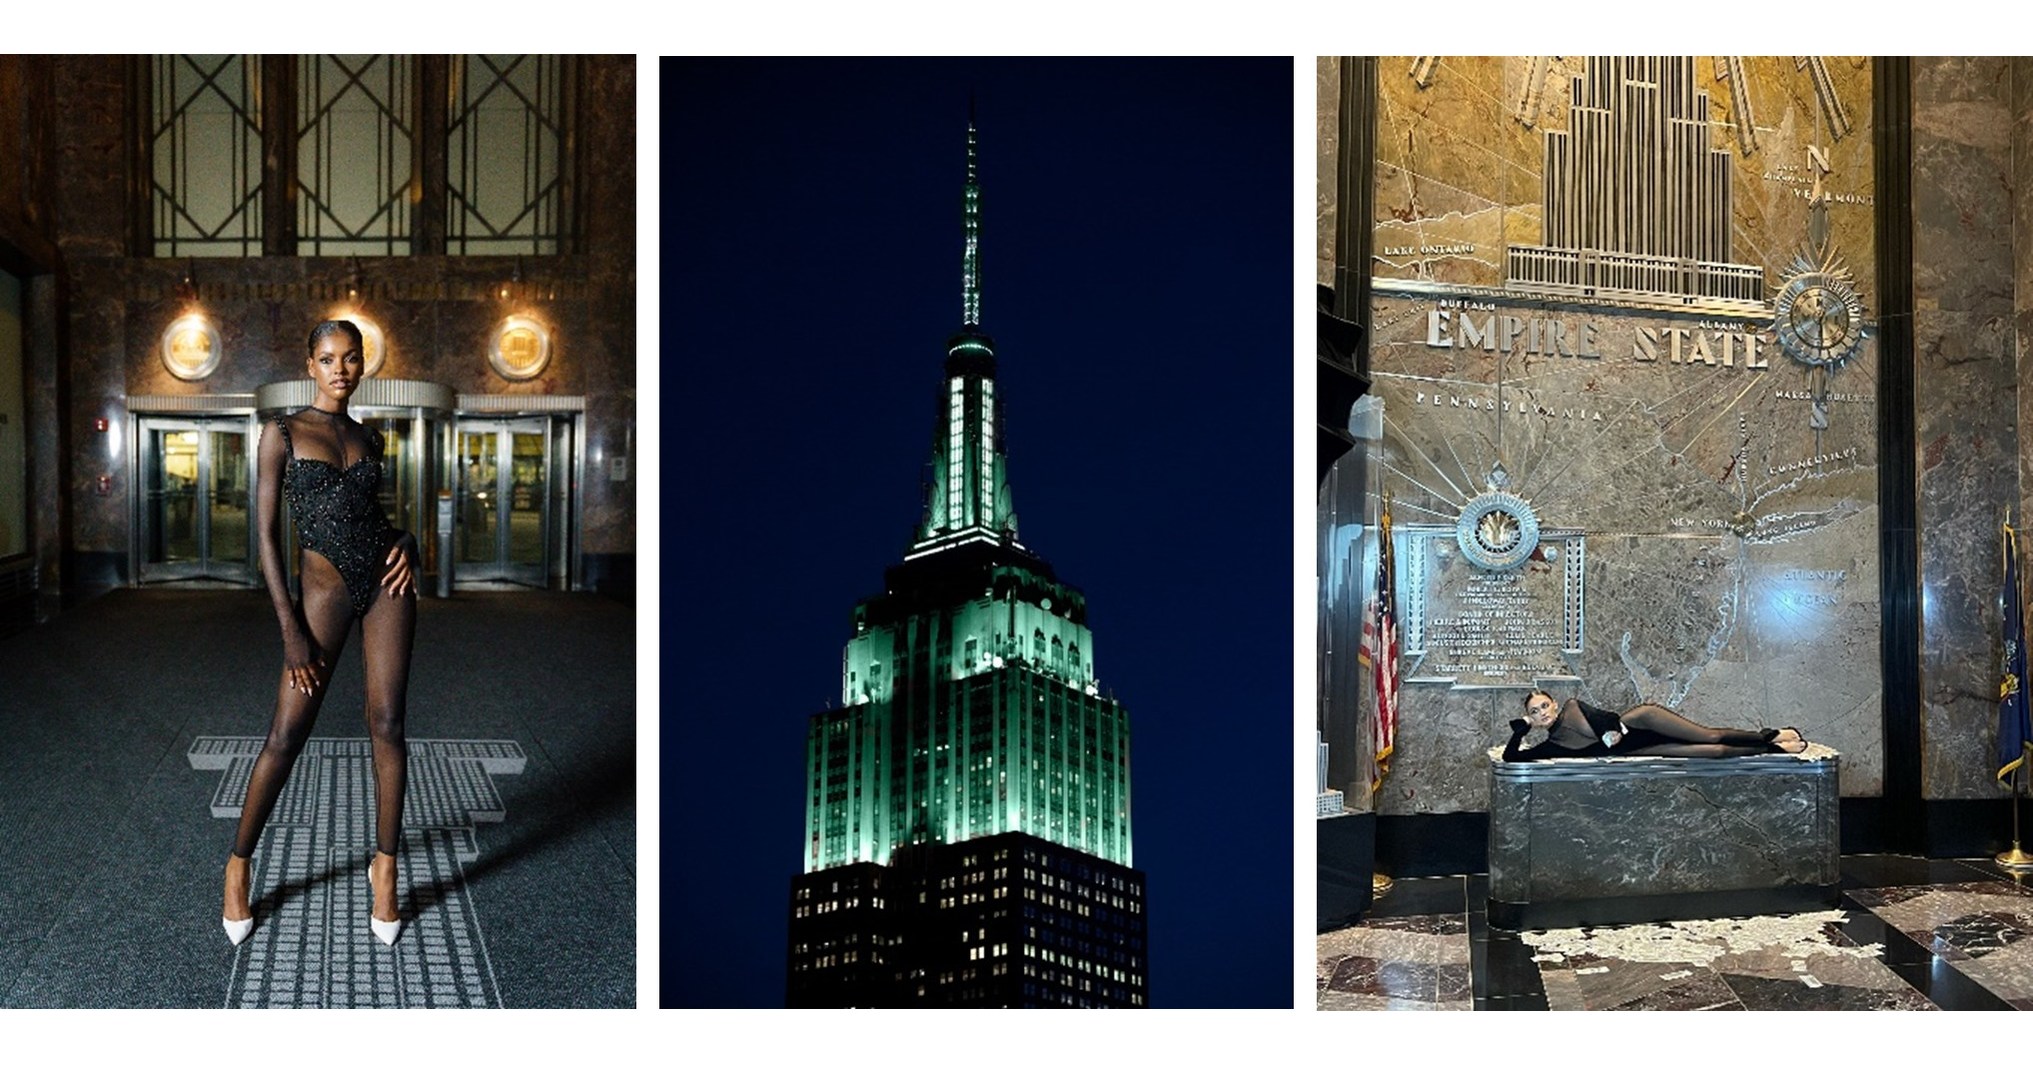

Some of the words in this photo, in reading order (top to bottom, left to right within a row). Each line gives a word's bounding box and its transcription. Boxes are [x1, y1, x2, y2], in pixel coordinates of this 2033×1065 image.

[1806, 145, 1830, 172] N
[1384, 246, 1417, 256] LAKE
[1421, 245, 1475, 255] ONTARIO
[1440, 300, 1496, 312] BUFFALO
[1699, 320, 1744, 330] ALBANY
[1427, 310, 1600, 357] EMPIRE
[1633, 326, 1769, 369] STATE
[1416, 392, 1602, 421] PENNSYLVANIA
[1810, 402, 1829, 430] S
[1670, 517, 1695, 527] NEW
